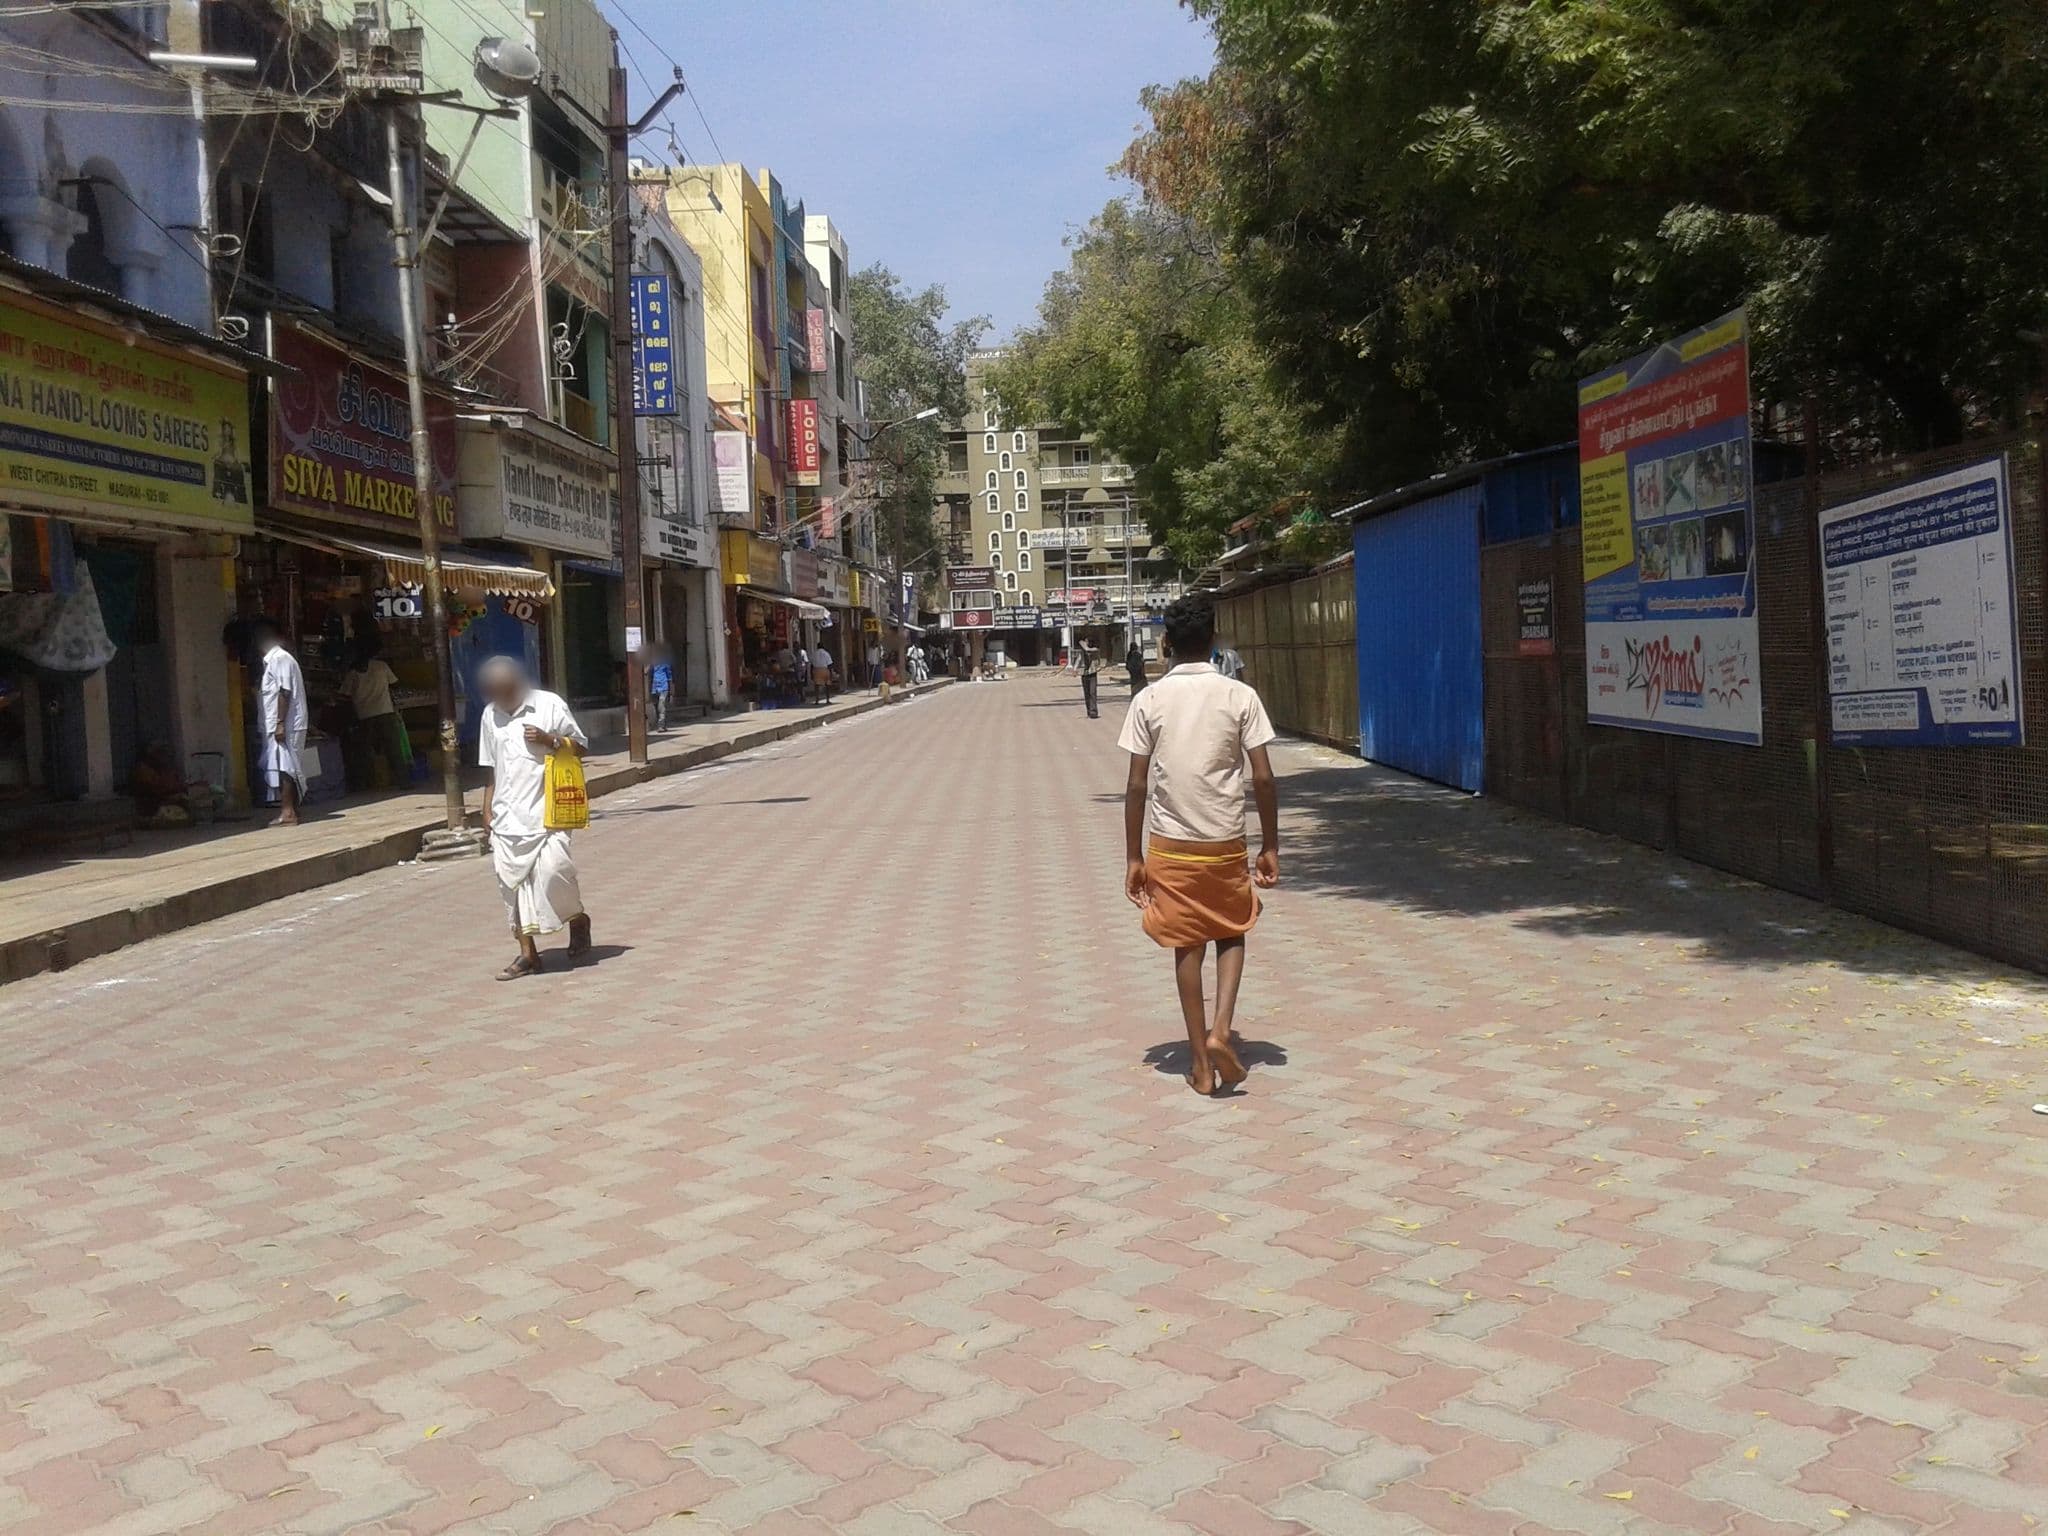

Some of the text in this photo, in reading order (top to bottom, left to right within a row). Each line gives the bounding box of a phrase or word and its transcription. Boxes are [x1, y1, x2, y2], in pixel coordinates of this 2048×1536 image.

[31, 380, 148, 439] HAND-LOOMS
[153, 412, 209, 452] SAREES
[803, 404, 817, 467] LODGE
[9, 464, 33, 486] WEST
[69, 475, 98, 494] STREET
[282, 453, 337, 503] SIVA
[343, 469, 455, 527] MARKENG
[1841, 535, 1863, 547] PRICE
[1863, 529, 1887, 543] POOJA
[1888, 522, 1909, 535] SHOP
[1910, 517, 1928, 530] RUN
[1929, 513, 1941, 525] BY
[1942, 510, 1960, 522] THE
[1961, 500, 1996, 516] TEMPLE
[376, 597, 414, 617] 10
[506, 597, 533, 620] 10
[864, 620, 877, 630] 31
